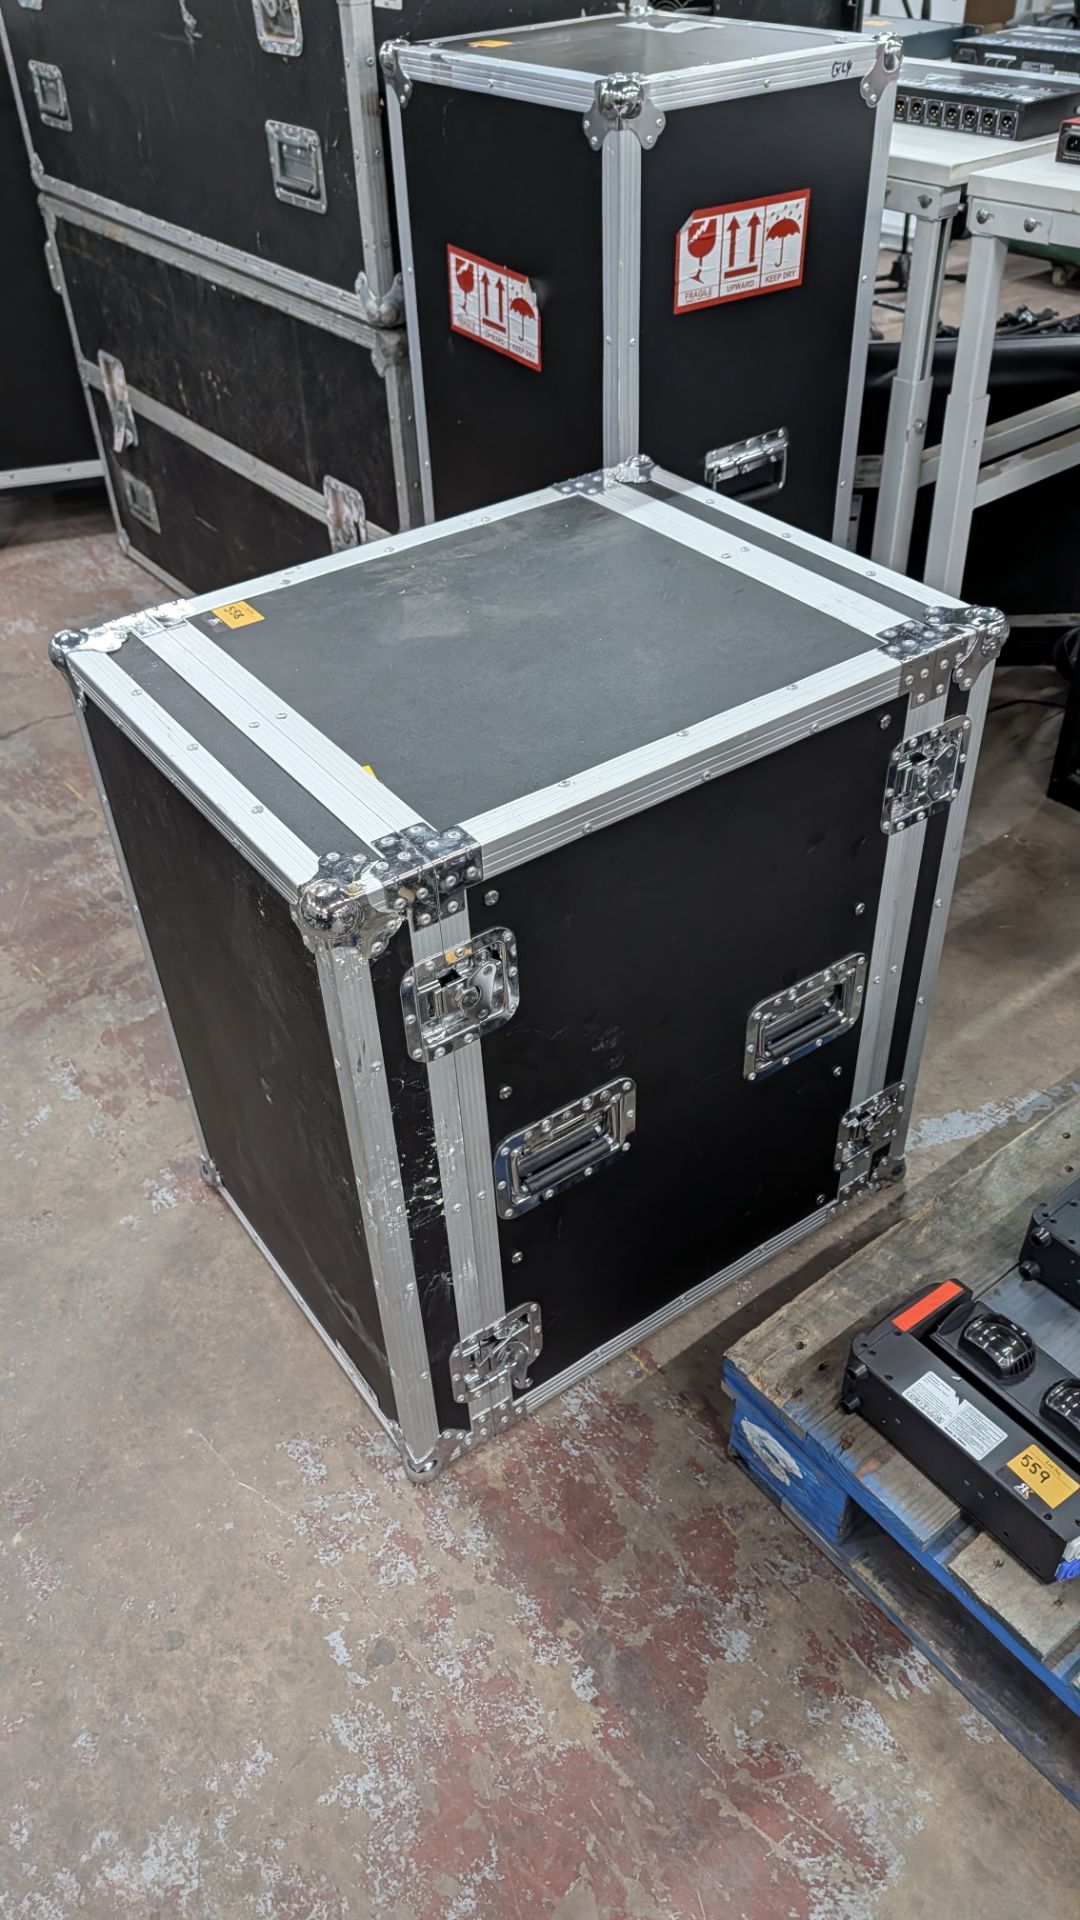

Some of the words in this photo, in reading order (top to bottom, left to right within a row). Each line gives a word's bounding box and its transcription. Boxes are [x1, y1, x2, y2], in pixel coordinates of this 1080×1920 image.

[765, 273, 782, 284] KEEP
[782, 270, 796, 281] DRY
[726, 280, 754, 292] UPWARD
[685, 288, 712, 300] FRAGILE
[1021, 1455, 1050, 1483] 559
